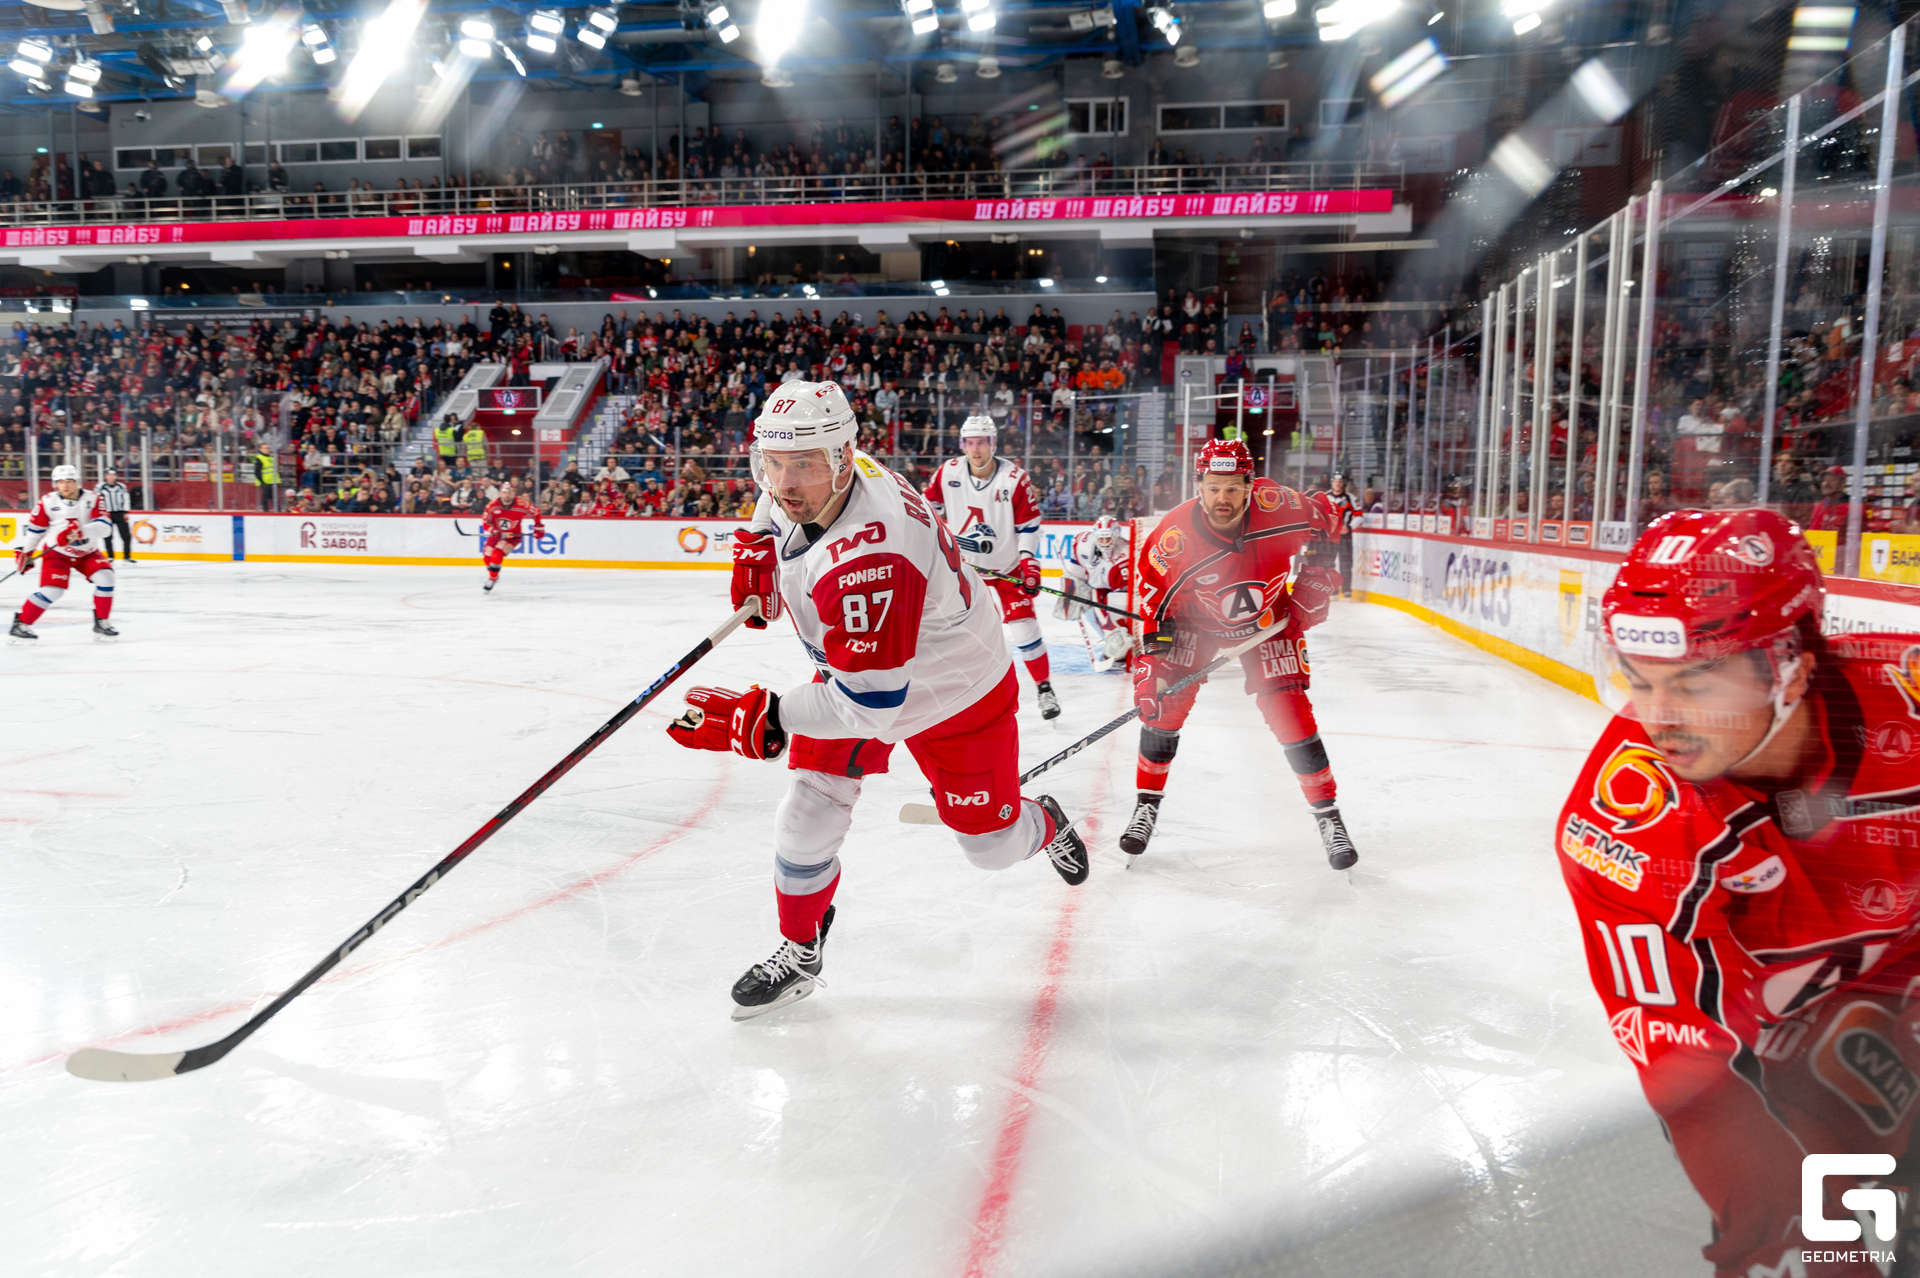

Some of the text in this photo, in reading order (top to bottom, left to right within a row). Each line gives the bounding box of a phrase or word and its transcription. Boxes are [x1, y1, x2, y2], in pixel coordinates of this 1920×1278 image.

[974, 198, 1057, 220] ШАЙБУ
[1091, 195, 1176, 218] ШАЙБУ
[1212, 192, 1298, 215] ШАЙБУ
[407, 215, 478, 236] ШАЙБУ
[508, 211, 581, 232] ШАЙБУ
[612, 208, 687, 229] ШАЙБУ
[6, 226, 69, 246] ШАЙБУ
[97, 224, 161, 244] ШАЙБУ
[772, 399, 796, 415] 87
[761, 429, 794, 440] согаз
[1211, 460, 1236, 468] согаз
[162, 525, 203, 534] УГМК
[321, 538, 368, 551] ЗАВОД
[1648, 535, 1697, 564] 10
[838, 565, 894, 589] FONBET
[1445, 552, 1511, 627] согаз
[842, 589, 894, 633] 87
[1616, 626, 1680, 645] согаз
[1165, 647, 1195, 668] AND
[1259, 638, 1295, 661] SIMA
[1262, 655, 1299, 679] LAND
[1027, 738, 1088, 782] CCM
[945, 791, 990, 807] РЖД
[1566, 813, 1650, 872] УГМК
[339, 870, 439, 960] CCM
[1595, 919, 1677, 1006] 10
[1649, 1021, 1710, 1049] РМК
